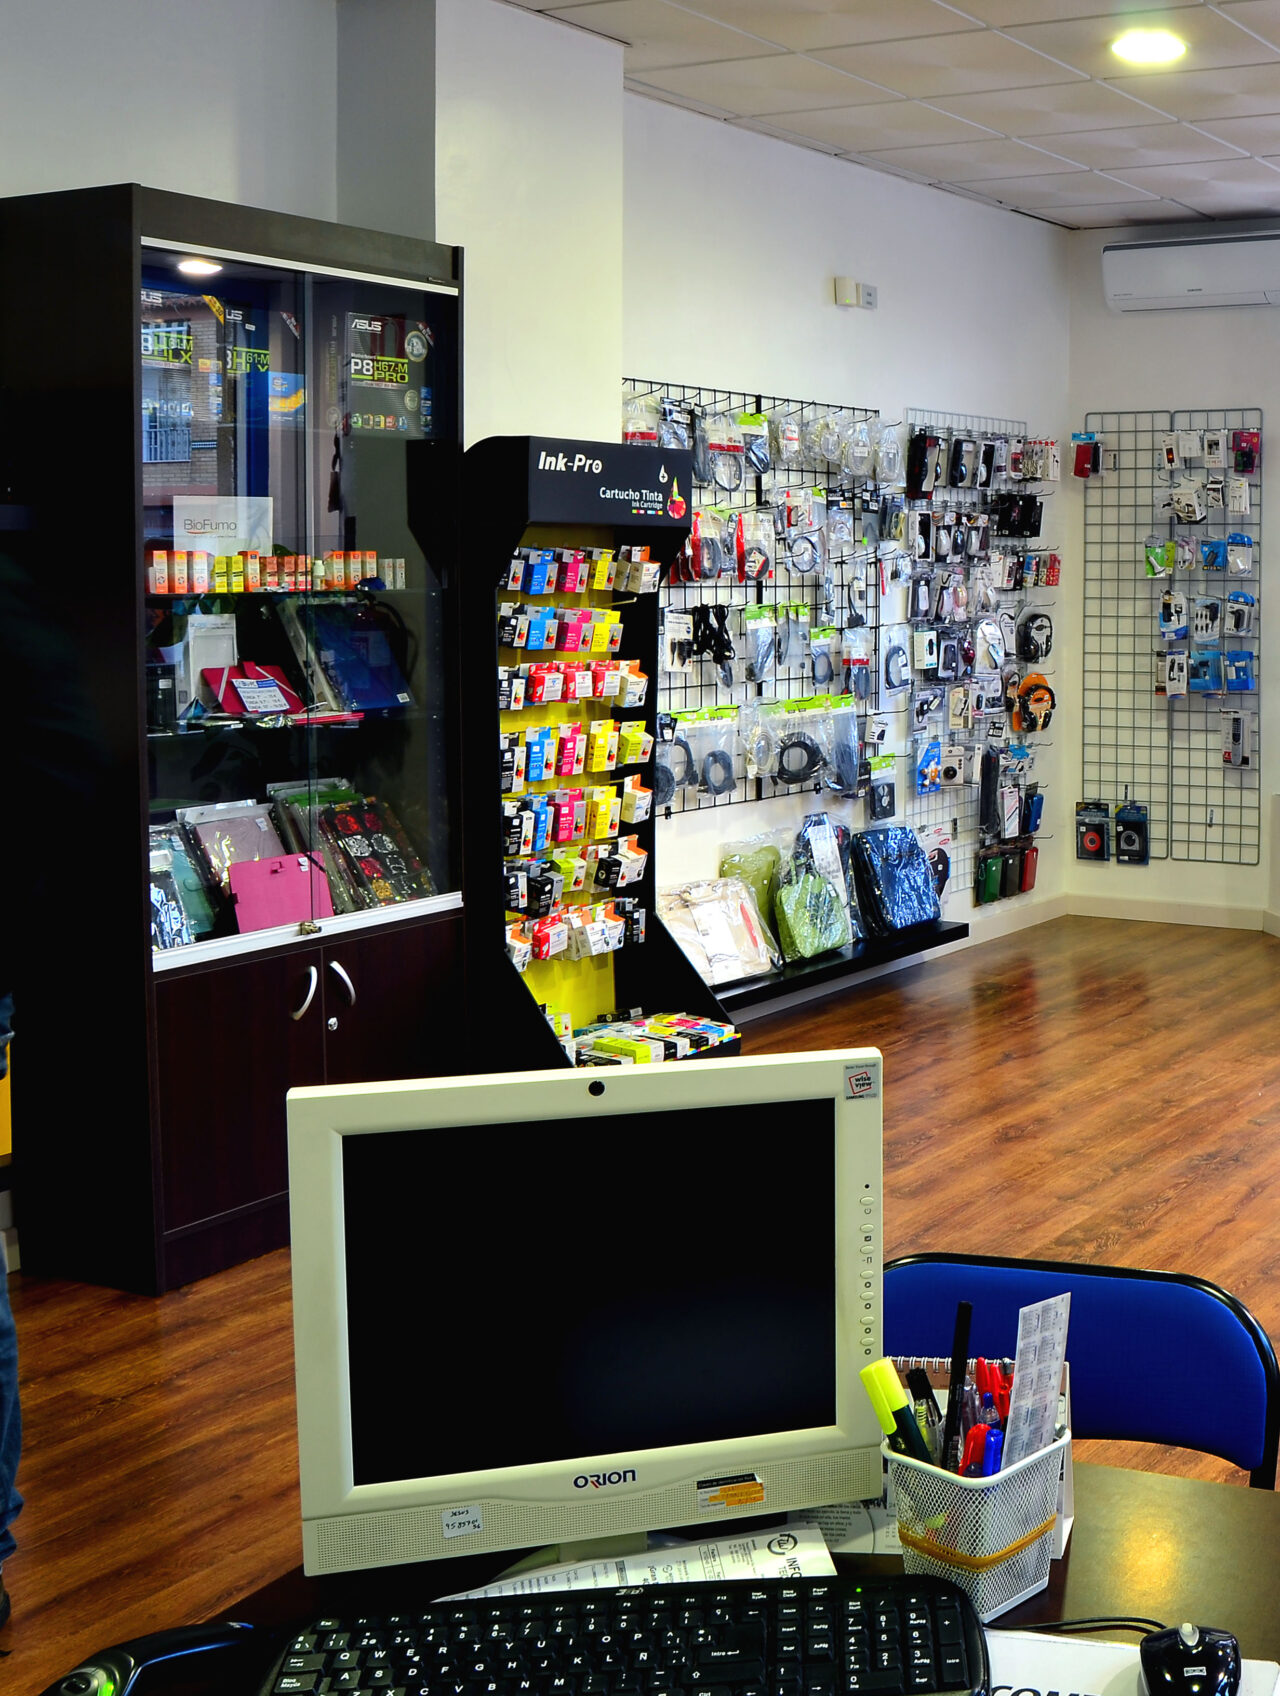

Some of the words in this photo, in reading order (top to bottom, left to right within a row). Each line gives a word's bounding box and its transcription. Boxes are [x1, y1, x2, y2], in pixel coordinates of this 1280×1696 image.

[351, 319, 382, 332] ASUS
[374, 372, 409, 383] PRO
[538, 451, 603, 473] Ink-Pro
[599, 487, 640, 501] Cartucho
[641, 489, 663, 502] Tinta
[631, 500, 640, 508] Ink
[640, 501, 663, 509] Cartridge
[183, 518, 237, 532] BioFumo
[573, 1469, 636, 1488] ORION
[505, 1642, 514, 1650] Y
[340, 1652, 350, 1660] Q
[374, 1651, 386, 1659] W
[639, 1652, 648, 1660] Ñ
[340, 1672, 349, 1680] A
[554, 1678, 565, 1686] M
[454, 1685, 464, 1693] V
